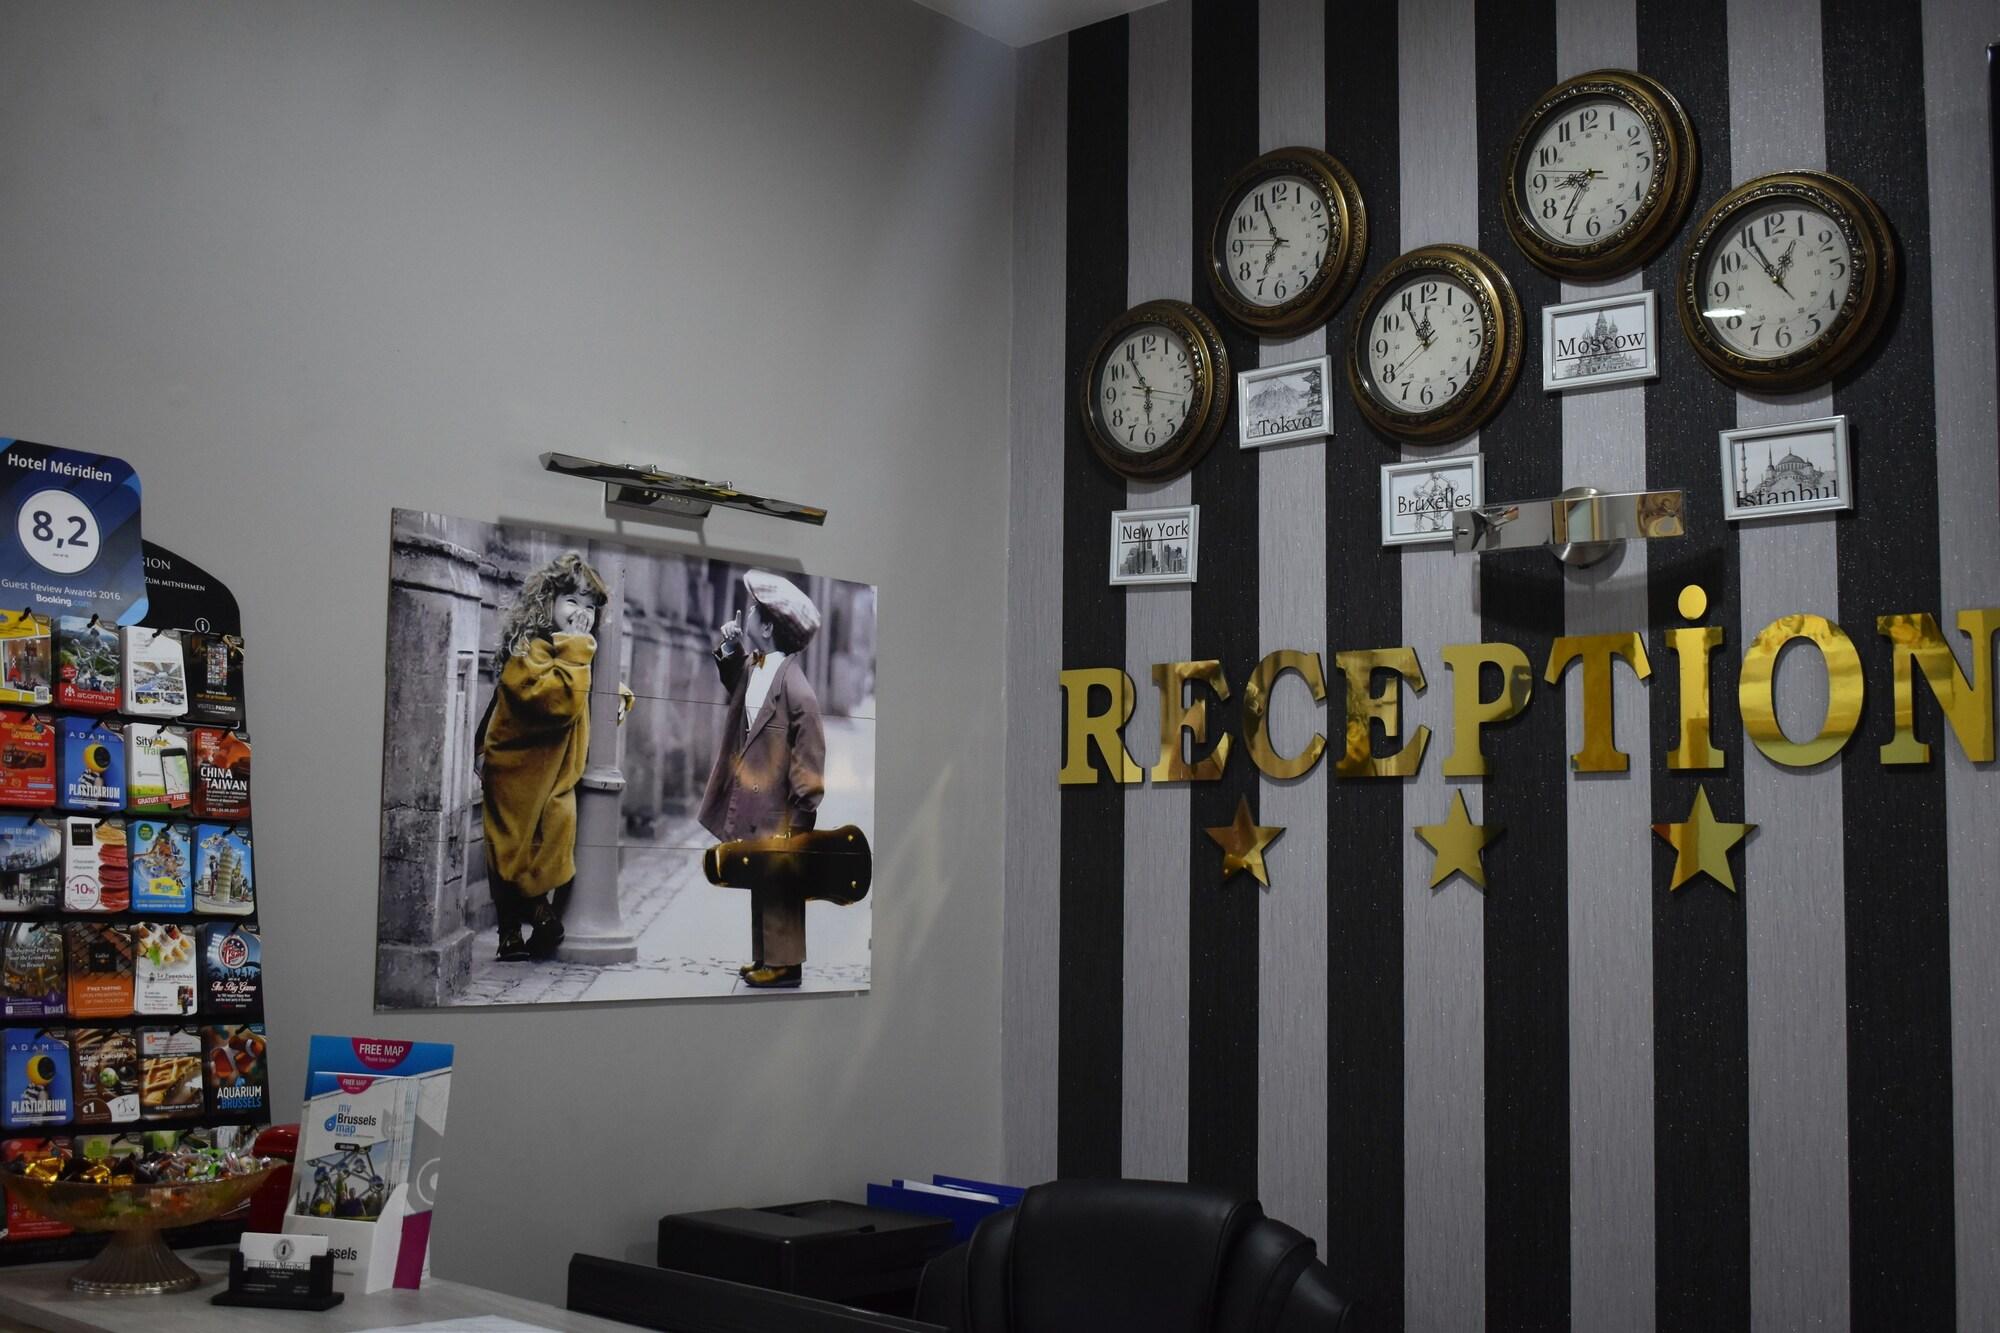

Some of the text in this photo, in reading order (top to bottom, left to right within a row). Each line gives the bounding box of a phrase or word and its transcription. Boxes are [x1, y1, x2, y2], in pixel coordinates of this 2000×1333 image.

[1579, 108, 1598, 132] 12
[1609, 111, 1615, 131] 1
[1559, 121, 1570, 142] 11
[1627, 126, 1640, 147] 2
[1539, 145, 1557, 167] 10
[1636, 151, 1649, 172] 3
[1271, 183, 1287, 203] 12
[1533, 173, 1547, 194] 9
[1255, 193, 1264, 212] 11
[1296, 186, 1300, 204] 1
[1311, 200, 1321, 219] 2
[1543, 198, 1557, 219] 8
[1612, 203, 1626, 226] 5
[1238, 215, 1253, 233] 10
[1317, 224, 1328, 243] 3
[1586, 215, 1600, 237] 6
[1764, 213, 1785, 237] 12
[1798, 214, 1804, 236] 1
[1232, 240, 1243, 257] 9
[1818, 230, 1833, 252] 2
[1239, 262, 1251, 281] 8
[1721, 252, 1740, 274] 10
[1829, 257, 1845, 280] 3
[1257, 278, 1265, 296] 7
[1274, 279, 1286, 299] 6
[1296, 271, 1307, 289] 5
[1420, 283, 1437, 303] 12
[1447, 287, 1452, 305] 1
[1714, 281, 1729, 303] 9
[1463, 303, 1474, 322] 2
[1383, 313, 1399, 333] 10
[1805, 313, 1821, 336] 5
[1142, 335, 1155, 353] 12
[1469, 328, 1481, 349] 3
[1751, 323, 1764, 346] 7
[1775, 325, 1792, 348] 6
[1164, 337, 1168, 355] 1
[1376, 339, 1388, 359] 9
[1557, 333, 1645, 357] Moscow
[1177, 352, 1187, 369] 2
[1111, 363, 1124, 381] 10
[1383, 364, 1395, 384] 8
[1184, 374, 1193, 392] 3
[1401, 382, 1411, 400] 7
[1444, 376, 1457, 396] 5
[1106, 387, 1116, 404] 9
[1420, 384, 1433, 405] 6
[1113, 409, 1123, 427] 8
[1164, 418, 1175, 437] 5
[1258, 416, 1312, 435] Tokyo
[1128, 425, 1136, 441] 7
[1145, 426, 1155, 445] 6
[8, 453, 112, 482] Hotel Méridien
[1398, 488, 1471, 513] Bruxelles
[1736, 480, 1837, 507] Istanbul
[33, 511, 88, 548] 8,2
[1123, 520, 1188, 540] New York
[2, 579, 120, 600] Guest Review Awards 2016
[162, 579, 205, 591] MITNEHMEN
[77, 692, 115, 702] atomium
[136, 736, 153, 746] Sity
[201, 767, 232, 779] CHINA
[69, 784, 120, 799] PLASTICARIUM
[206, 778, 247, 791] TAIWAN
[359, 1043, 404, 1056] FREE MAP
[217, 1086, 261, 1098] AQUARIUM
[11, 1099, 66, 1114] PLASTICARIUM
[338, 1104, 352, 1113] my
[336, 1124, 356, 1135] map
[337, 1114, 376, 1126] Brussels
